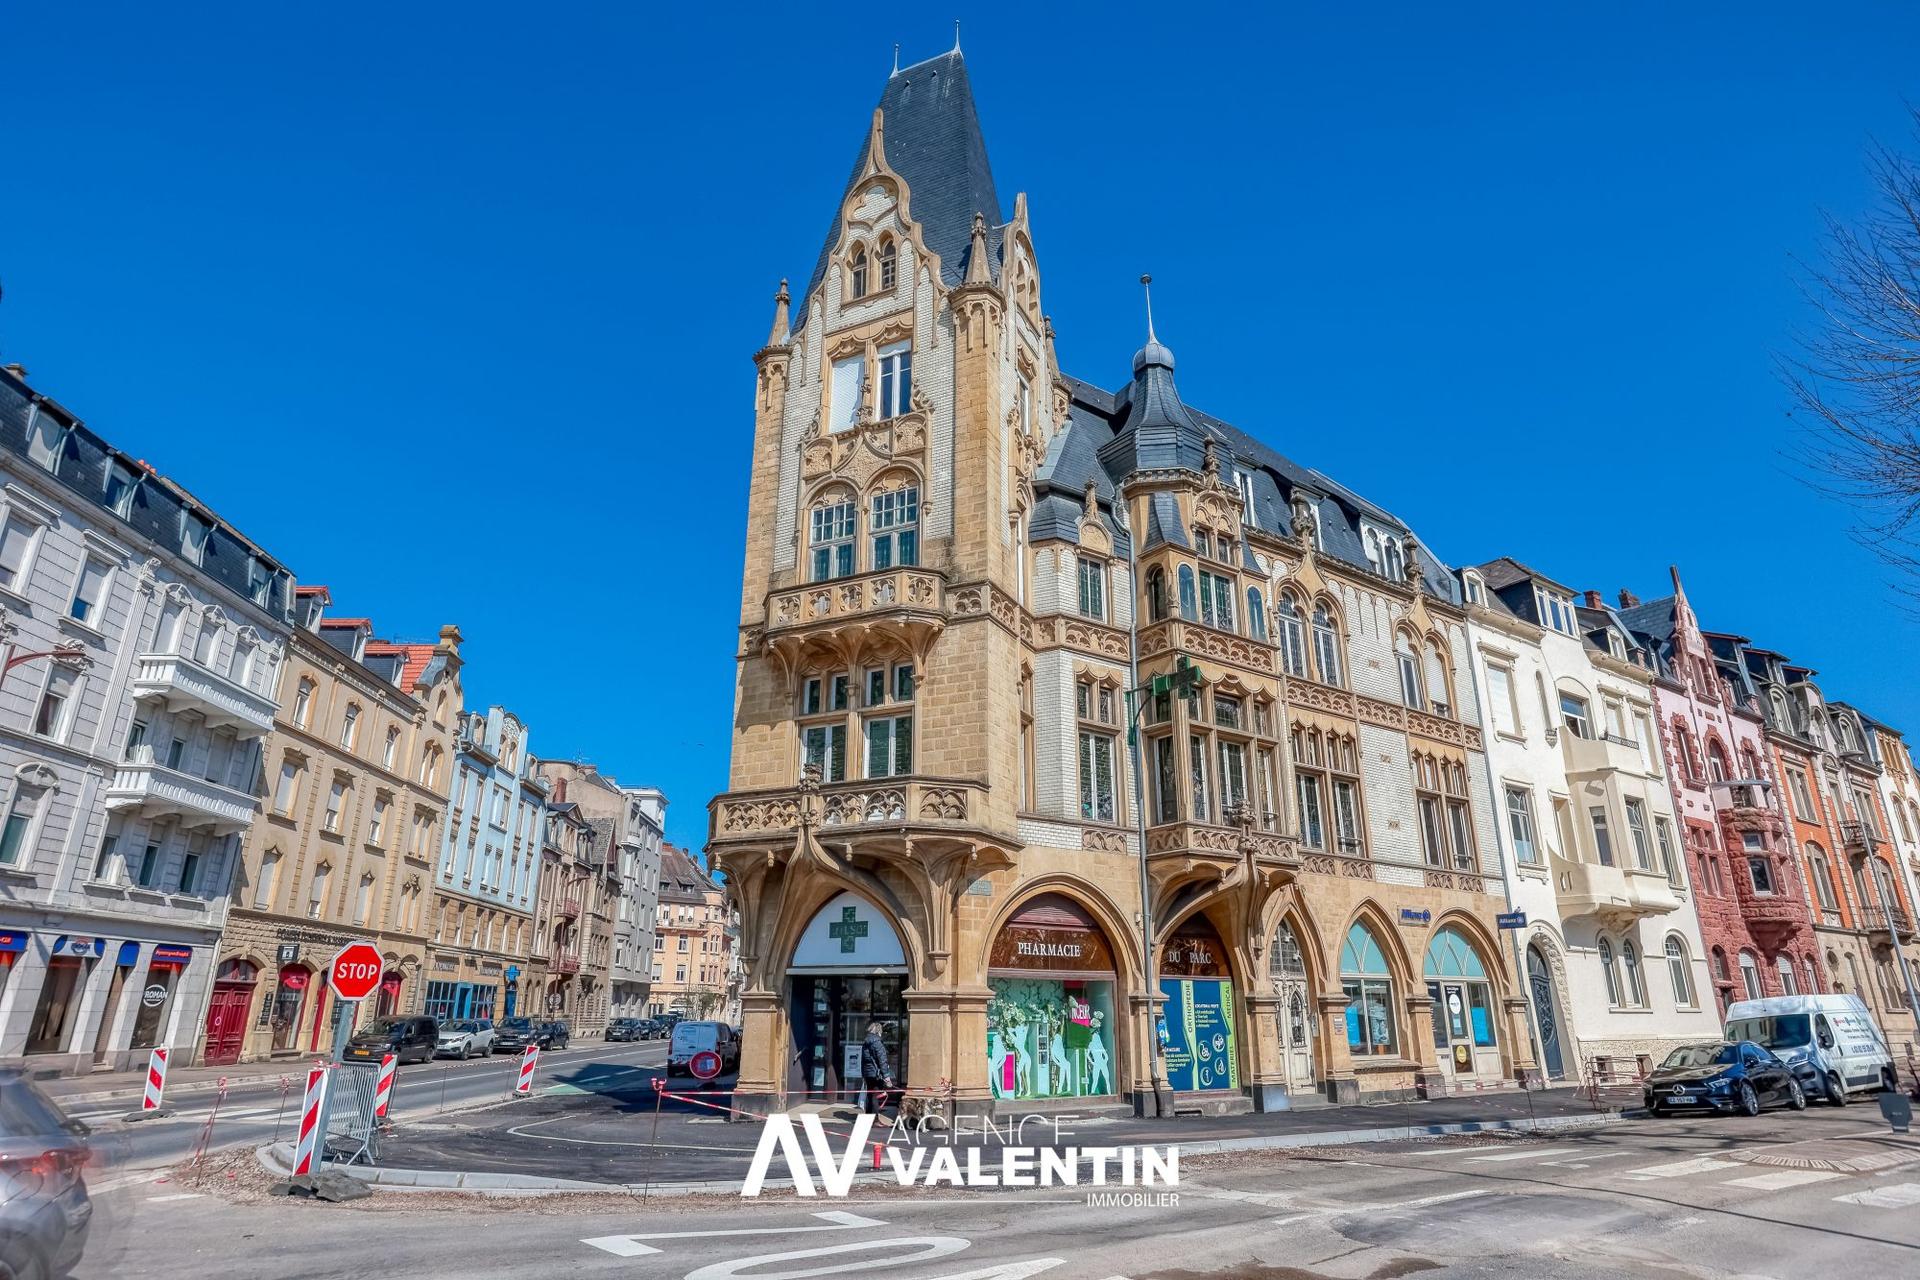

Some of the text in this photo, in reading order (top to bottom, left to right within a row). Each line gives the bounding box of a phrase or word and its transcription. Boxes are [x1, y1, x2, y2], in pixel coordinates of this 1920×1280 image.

[1401, 908, 1424, 919] Allianz
[1017, 942, 1081, 957] PHARMACIE
[1169, 951, 1212, 964] DU PARC
[337, 962, 378, 980] STOP
[144, 991, 169, 999] ROMAN
[1224, 986, 1232, 1019] MEDICAL
[1185, 983, 1193, 1033] ORTHOPEDIE
